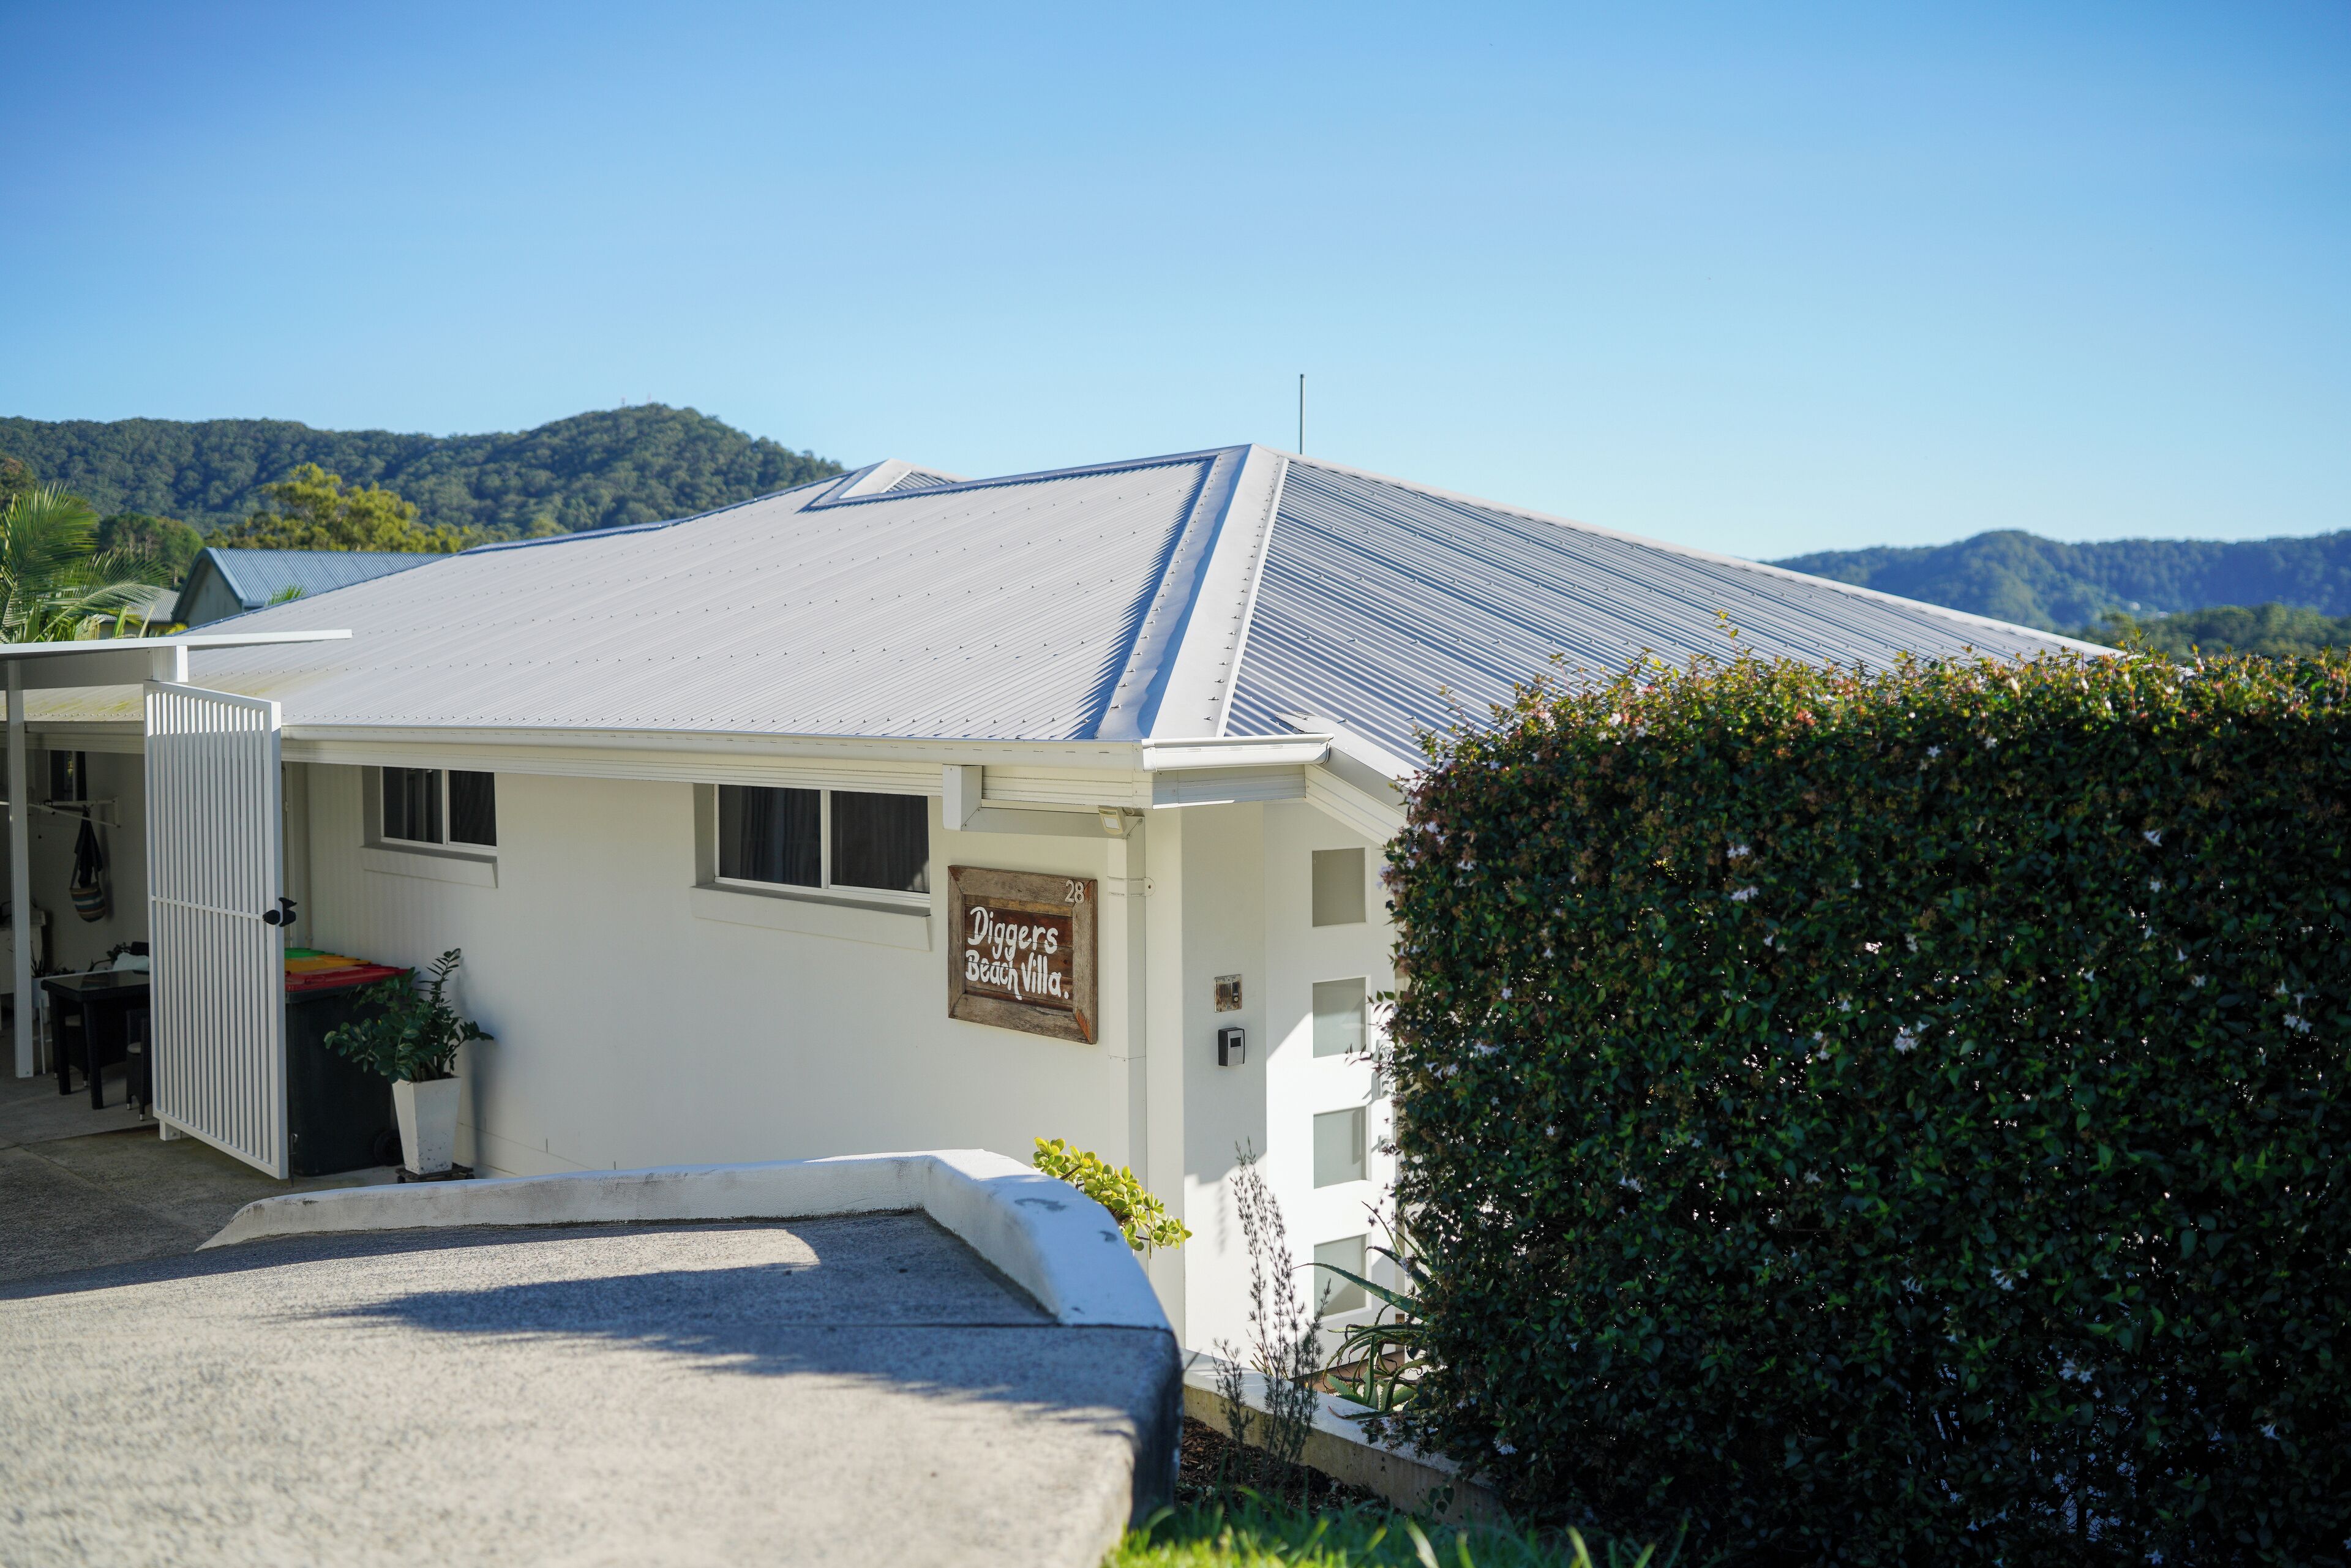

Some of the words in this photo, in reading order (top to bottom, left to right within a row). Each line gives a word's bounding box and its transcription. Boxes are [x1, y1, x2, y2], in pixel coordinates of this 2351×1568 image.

[1065, 879, 1085, 904] 28
[967, 906, 1059, 961] Diggers
[965, 949, 1022, 1000] Beach
[1021, 951, 1070, 1000] Villa.
